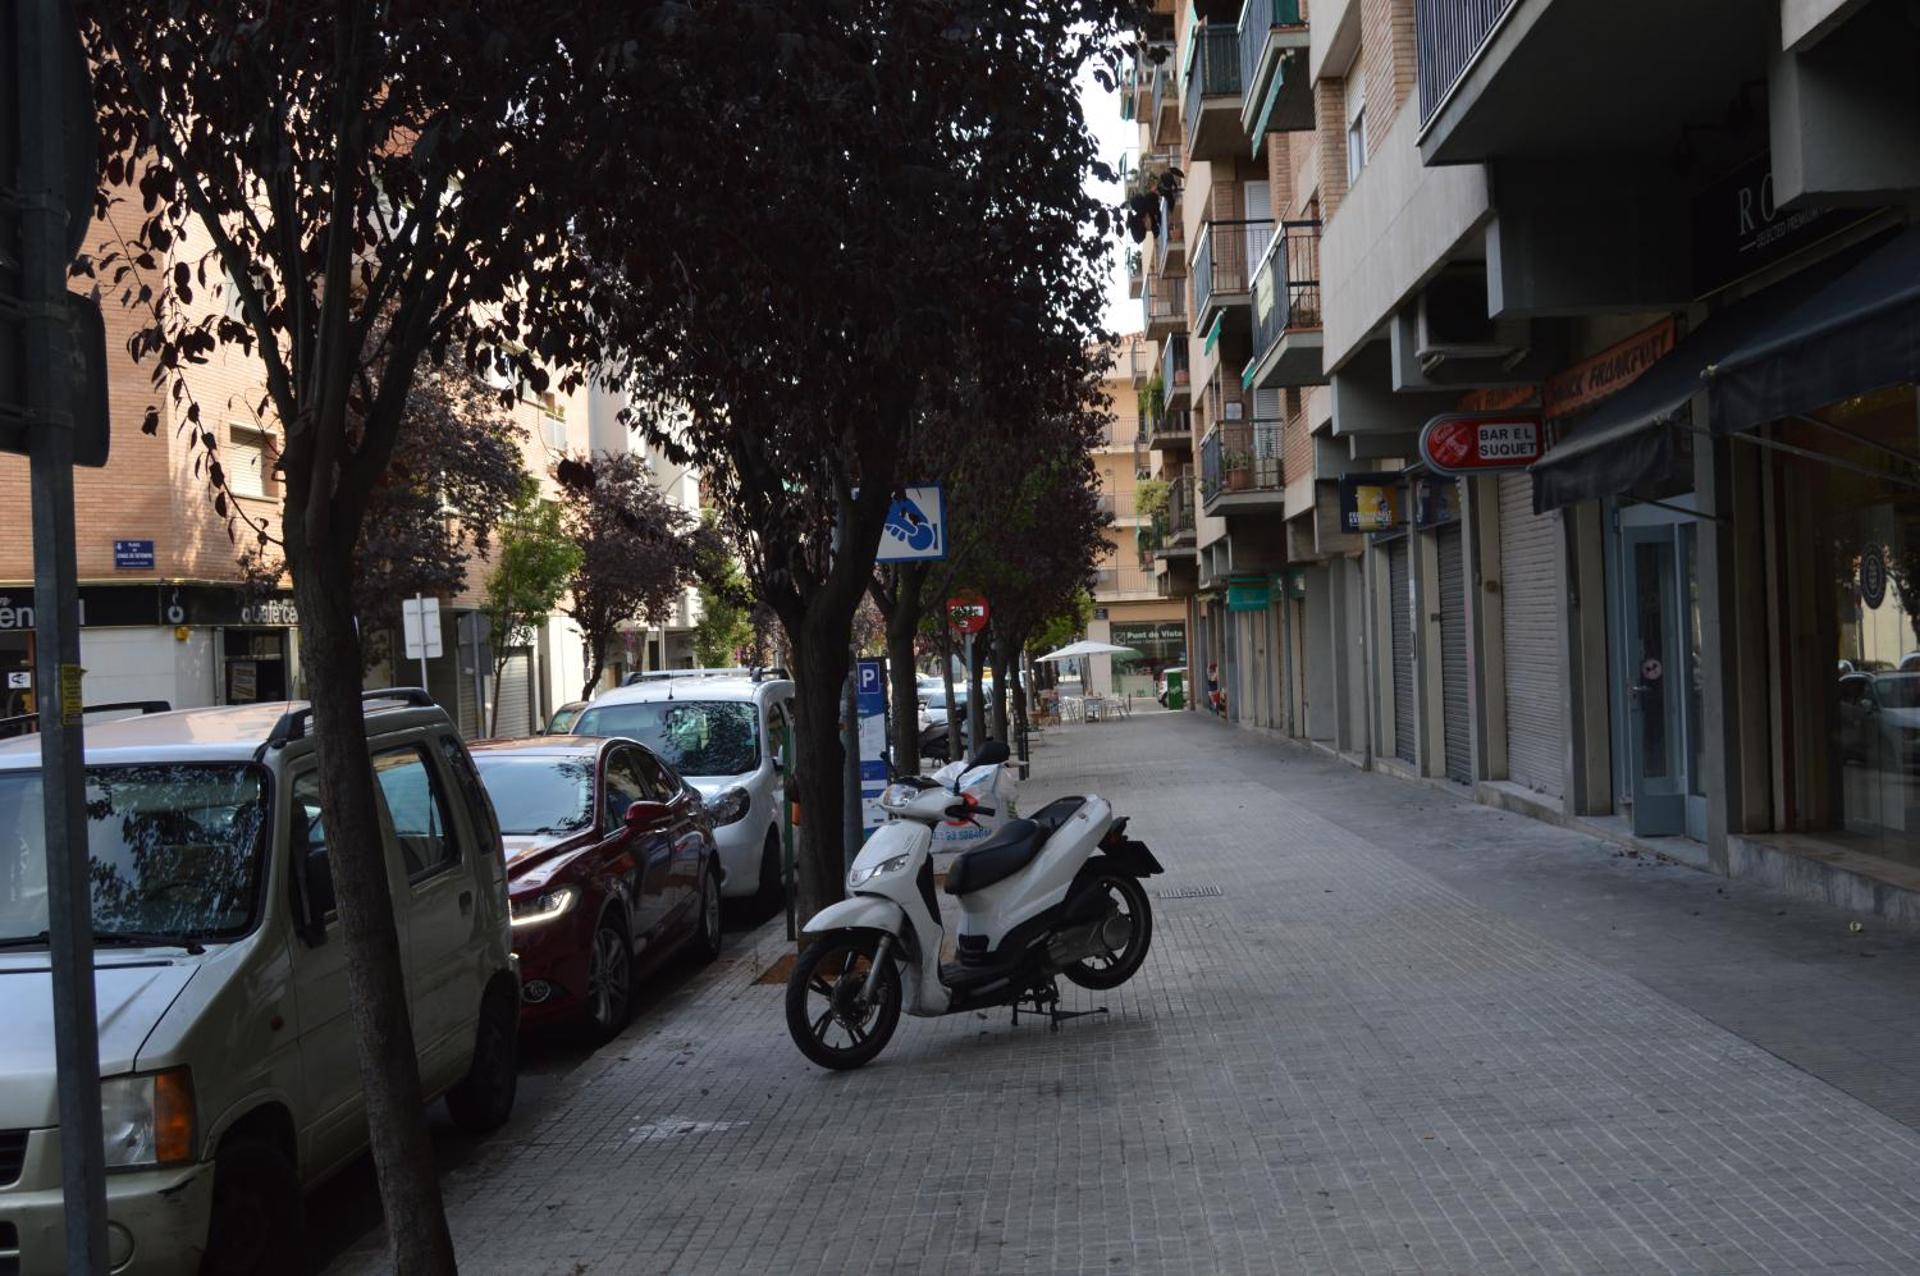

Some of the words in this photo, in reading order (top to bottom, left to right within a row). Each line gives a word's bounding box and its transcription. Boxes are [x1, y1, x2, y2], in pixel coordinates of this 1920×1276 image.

[1479, 427, 1509, 441] BAR
[1513, 427, 1533, 440] EL
[1479, 442, 1537, 457] SUQUET
[1127, 631, 1146, 639] Punt
[1161, 630, 1184, 638] Vista
[862, 669, 875, 688] P
